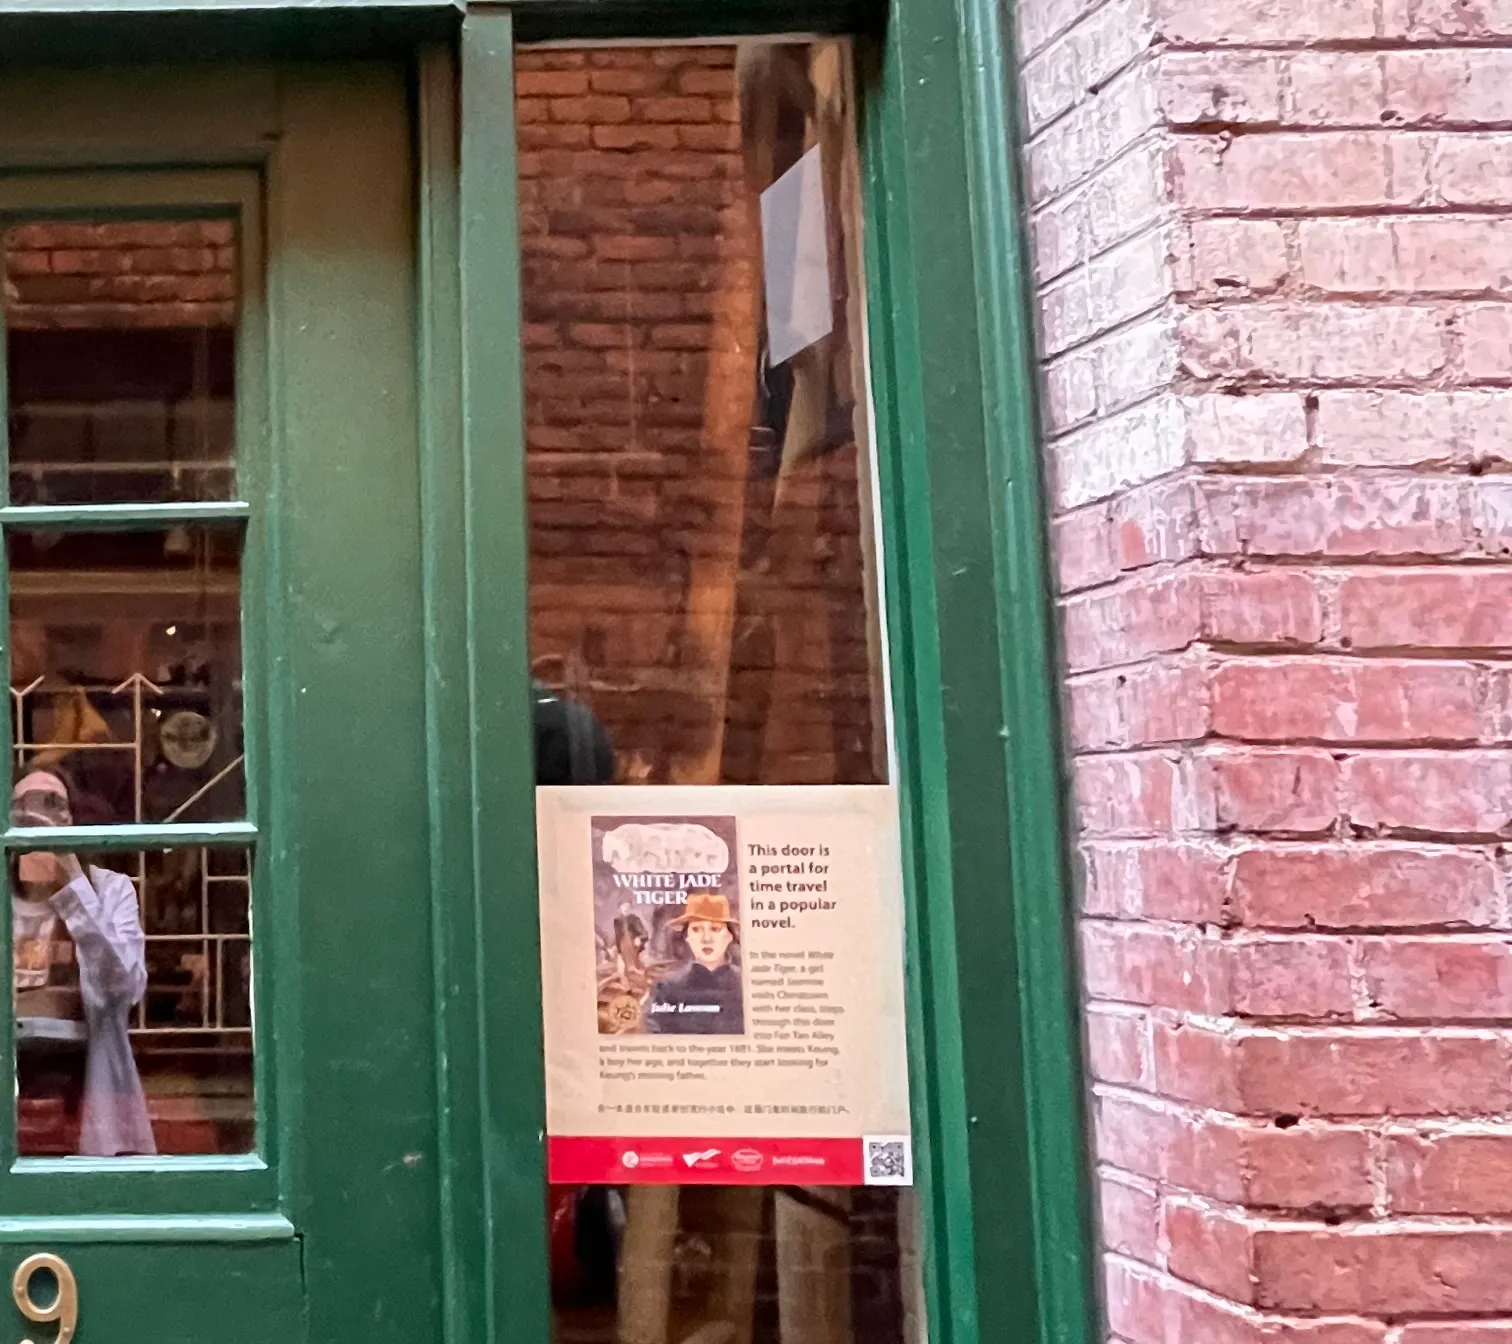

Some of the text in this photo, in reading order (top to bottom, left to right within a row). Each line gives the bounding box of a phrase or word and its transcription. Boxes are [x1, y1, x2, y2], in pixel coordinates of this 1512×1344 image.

[747, 843, 830, 857] This door is
[748, 861, 829, 877] a portal for
[613, 874, 723, 889] WHITE JADE
[749, 879, 828, 893] time travel
[632, 890, 689, 905] TIGER
[750, 896, 837, 913] in a popular
[751, 915, 796, 929] novel.
